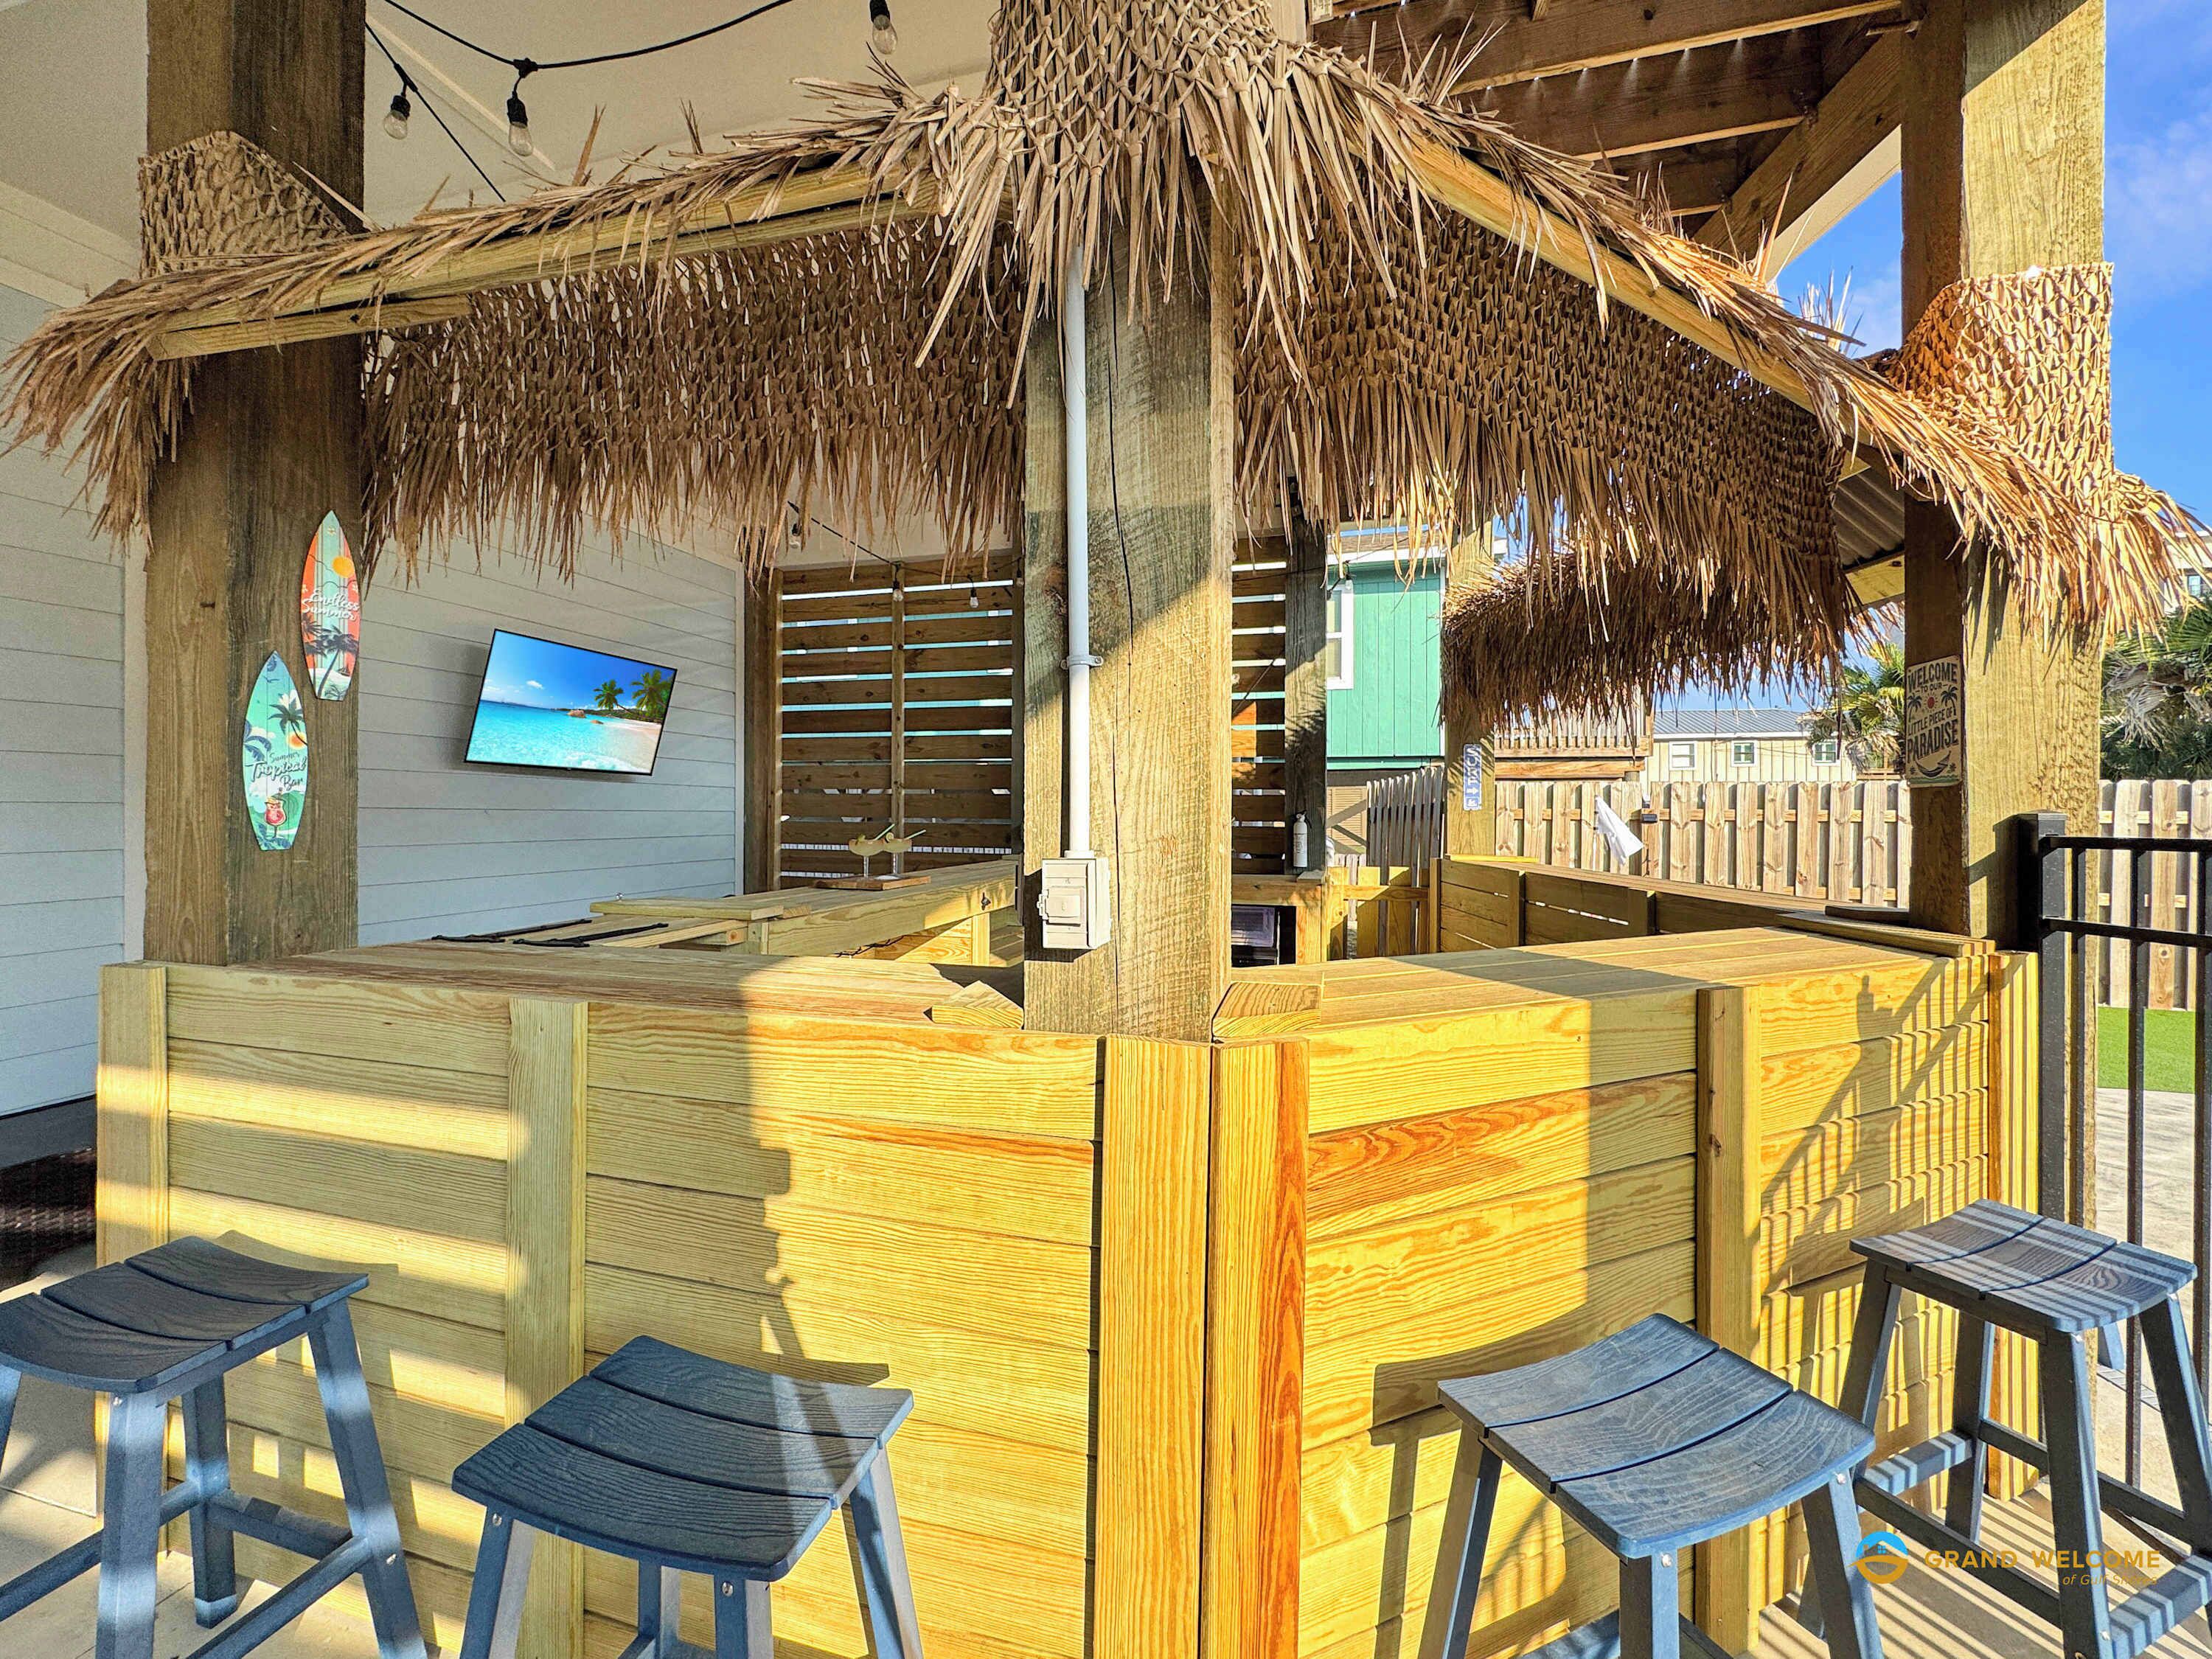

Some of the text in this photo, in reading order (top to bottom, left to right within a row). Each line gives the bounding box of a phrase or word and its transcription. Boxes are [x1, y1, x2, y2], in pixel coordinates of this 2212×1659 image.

[302, 598, 356, 622] Summer
[310, 588, 360, 611] Endless
[1907, 663, 1958, 692] WELCOME
[1921, 682, 1942, 692] TO OUR
[1907, 706, 1953, 736] LITTLE PIECE OF
[1907, 720, 1959, 763] PARADISE
[245, 756, 307, 782] Tropical
[269, 751, 300, 763] Summer
[279, 775, 303, 791] Bar
